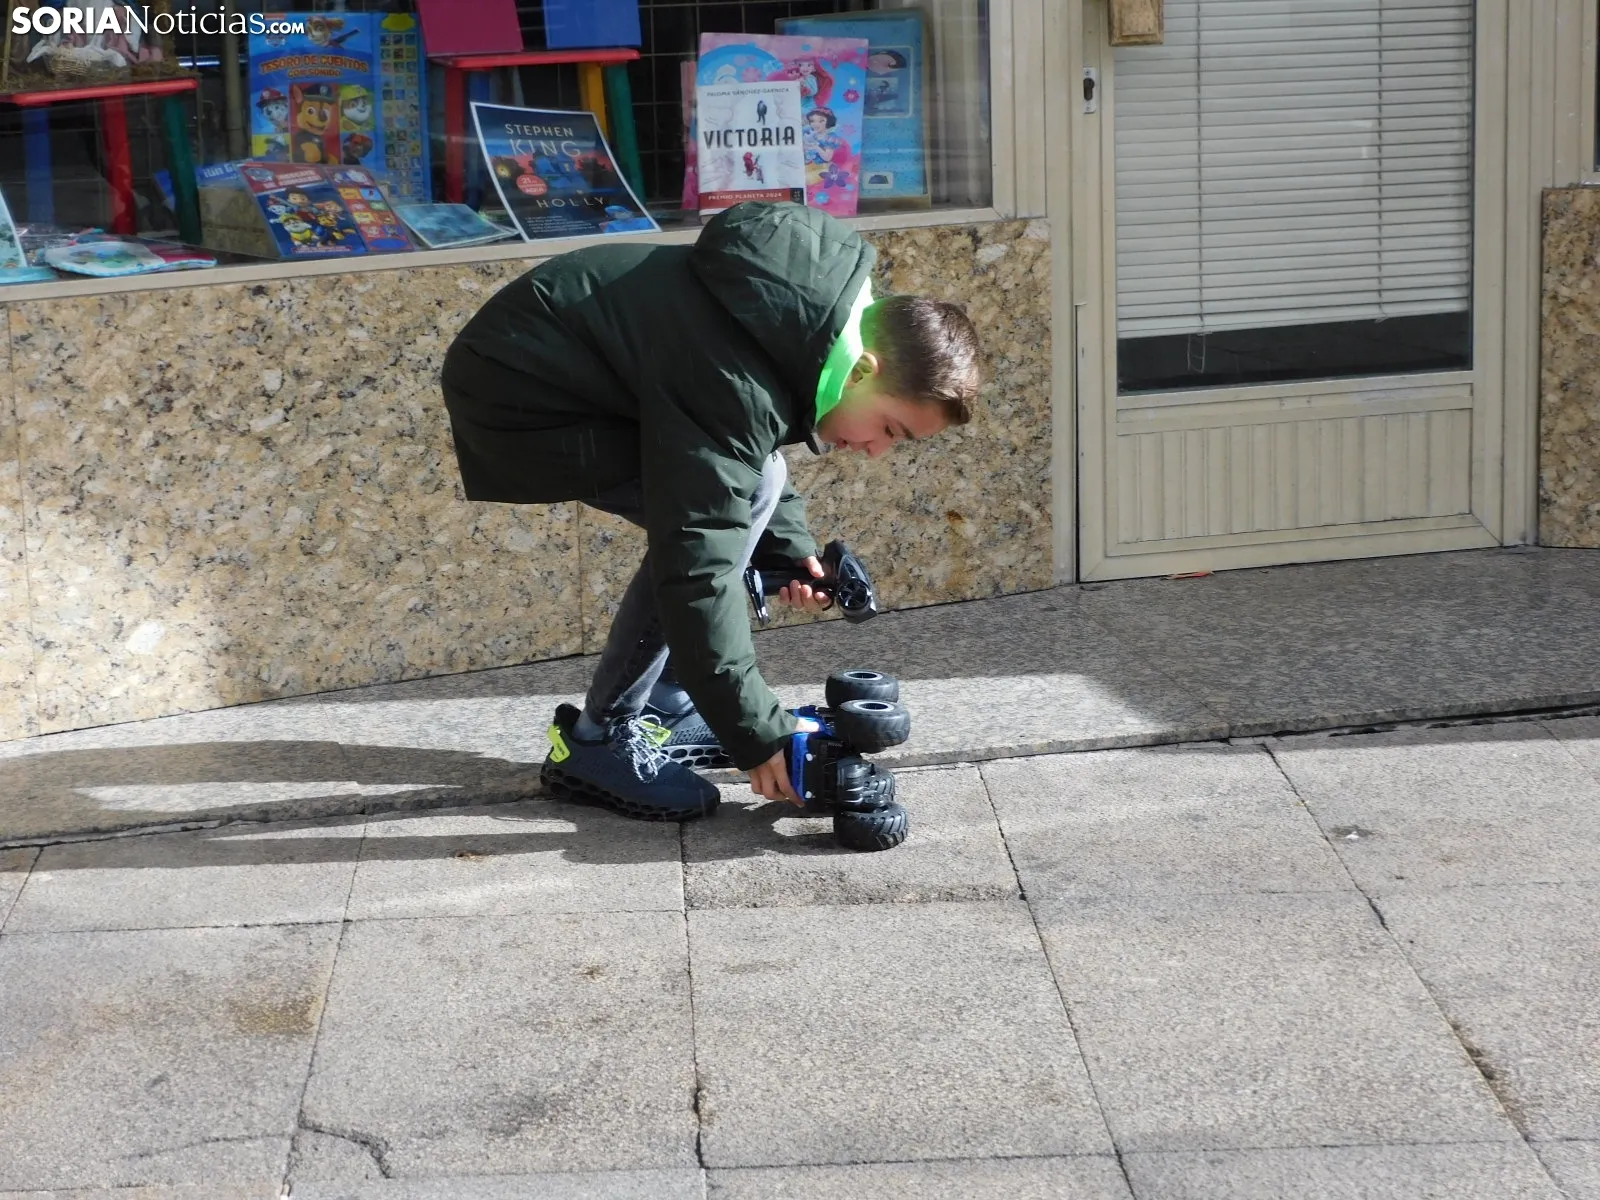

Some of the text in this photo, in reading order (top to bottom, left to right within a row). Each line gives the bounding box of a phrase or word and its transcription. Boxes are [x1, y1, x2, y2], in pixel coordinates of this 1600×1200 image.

[260, 55, 368, 74] TESORO DE CUENTOS
[504, 123, 574, 137] STEPHEN
[703, 126, 795, 149] VICTORIA
[509, 138, 581, 157] KING
[536, 196, 605, 209] HOLLY
